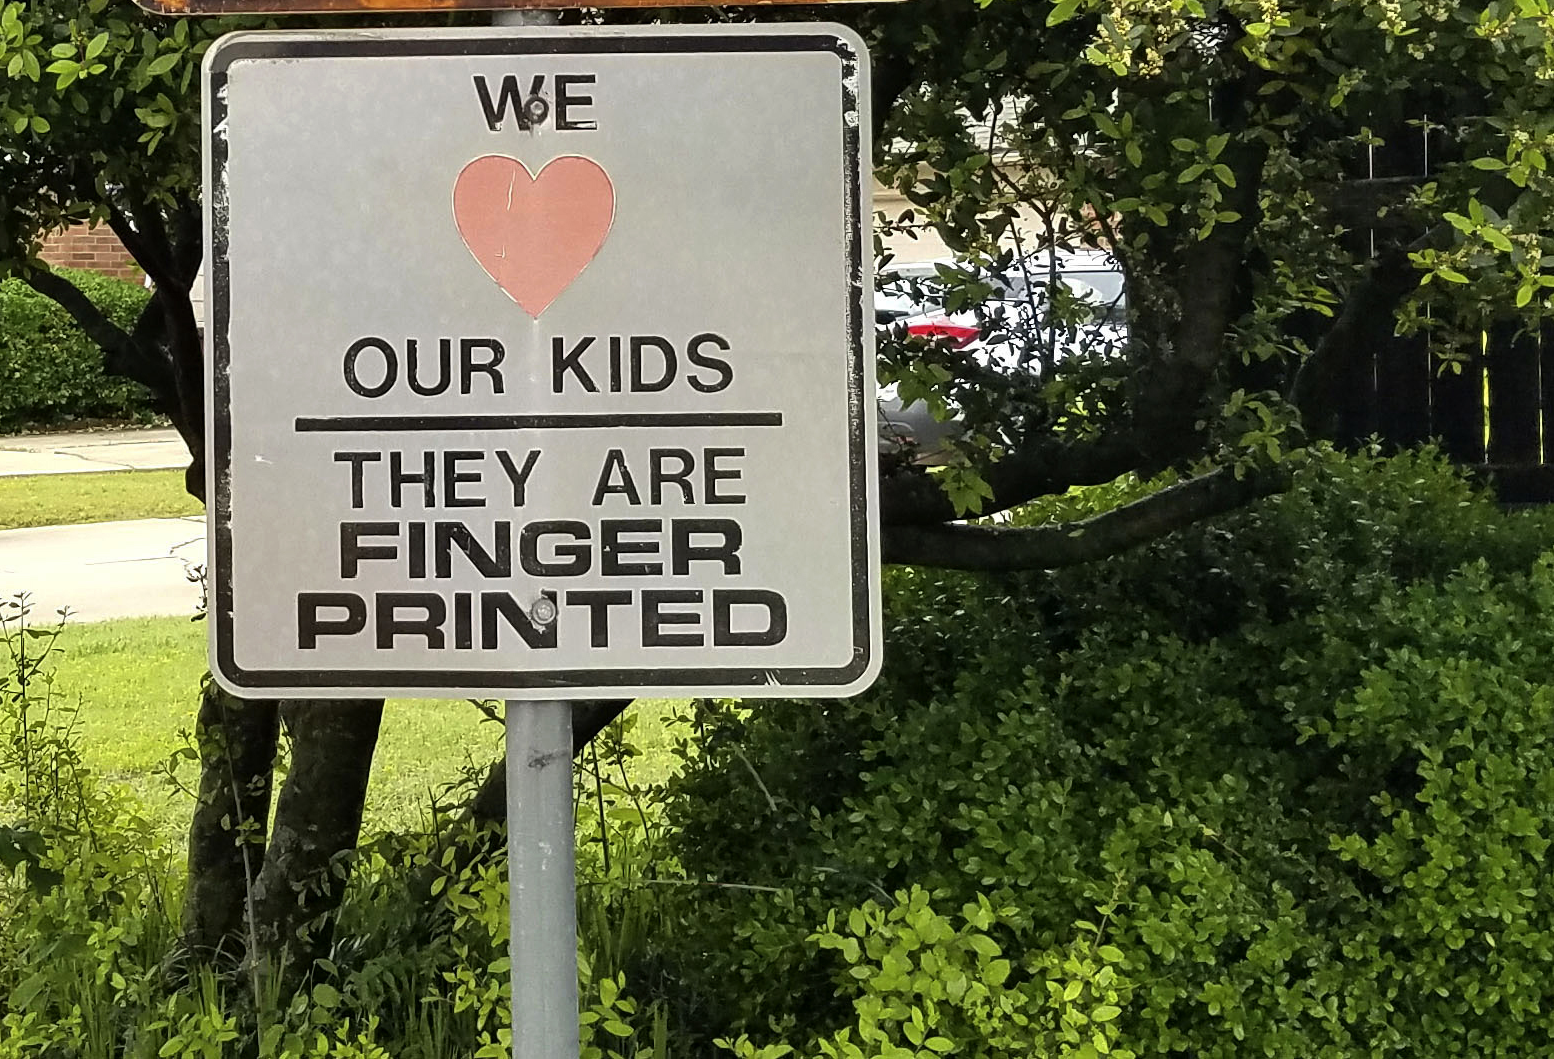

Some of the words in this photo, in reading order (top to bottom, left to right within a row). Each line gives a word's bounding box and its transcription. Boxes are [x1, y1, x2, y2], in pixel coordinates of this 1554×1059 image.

[474, 74, 598, 132] WE
[344, 336, 506, 398] OUR
[552, 333, 734, 394] KIDS
[334, 449, 541, 509] THEY
[592, 448, 747, 506] ARE
[339, 518, 743, 579] FINGER
[297, 589, 788, 650] PRINTED
